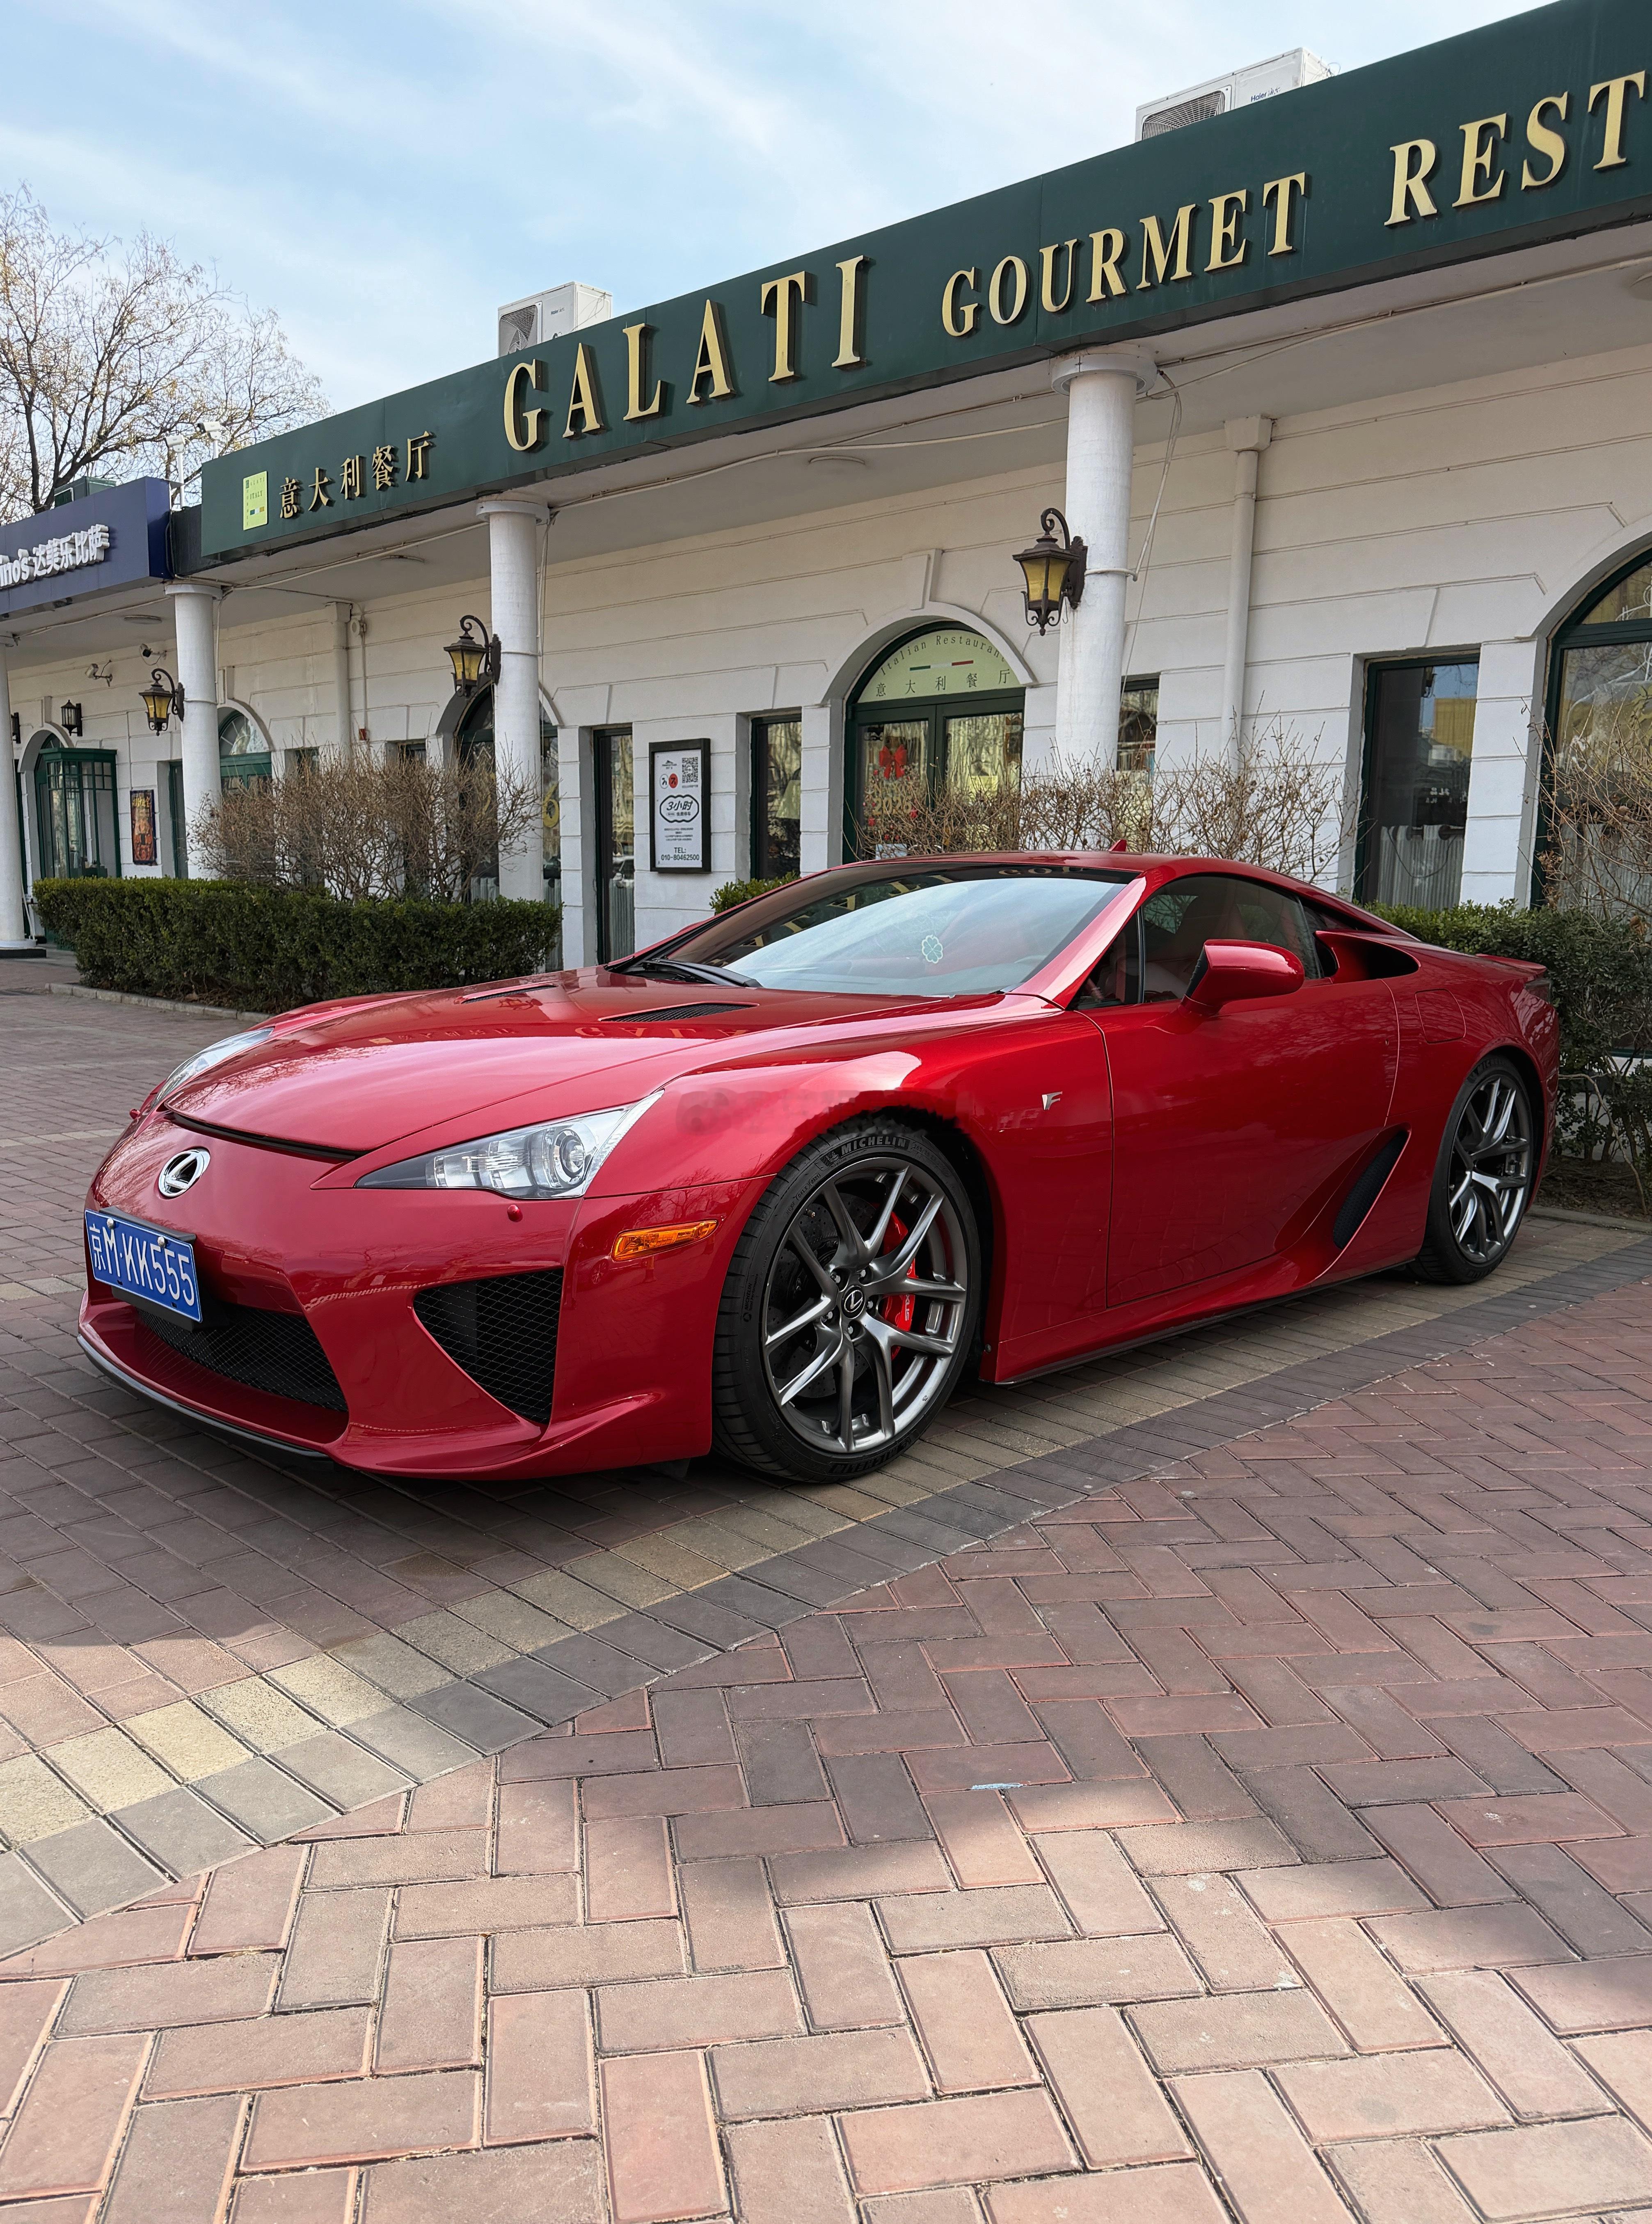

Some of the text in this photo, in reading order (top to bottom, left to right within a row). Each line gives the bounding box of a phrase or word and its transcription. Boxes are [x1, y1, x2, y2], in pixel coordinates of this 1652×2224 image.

[503, 70, 1646, 451] GALATI GOURMET REST
[279, 431, 432, 519] 意大利餐厅
[250, 490, 263, 500] ITALY
[29, 524, 107, 577] 达美乐比萨
[880, 641, 926, 676] Italian
[876, 669, 1011, 697] 意大利餐厅
[666, 800, 693, 811] 3小时
[841, 1136, 906, 1155] MICHELIN
